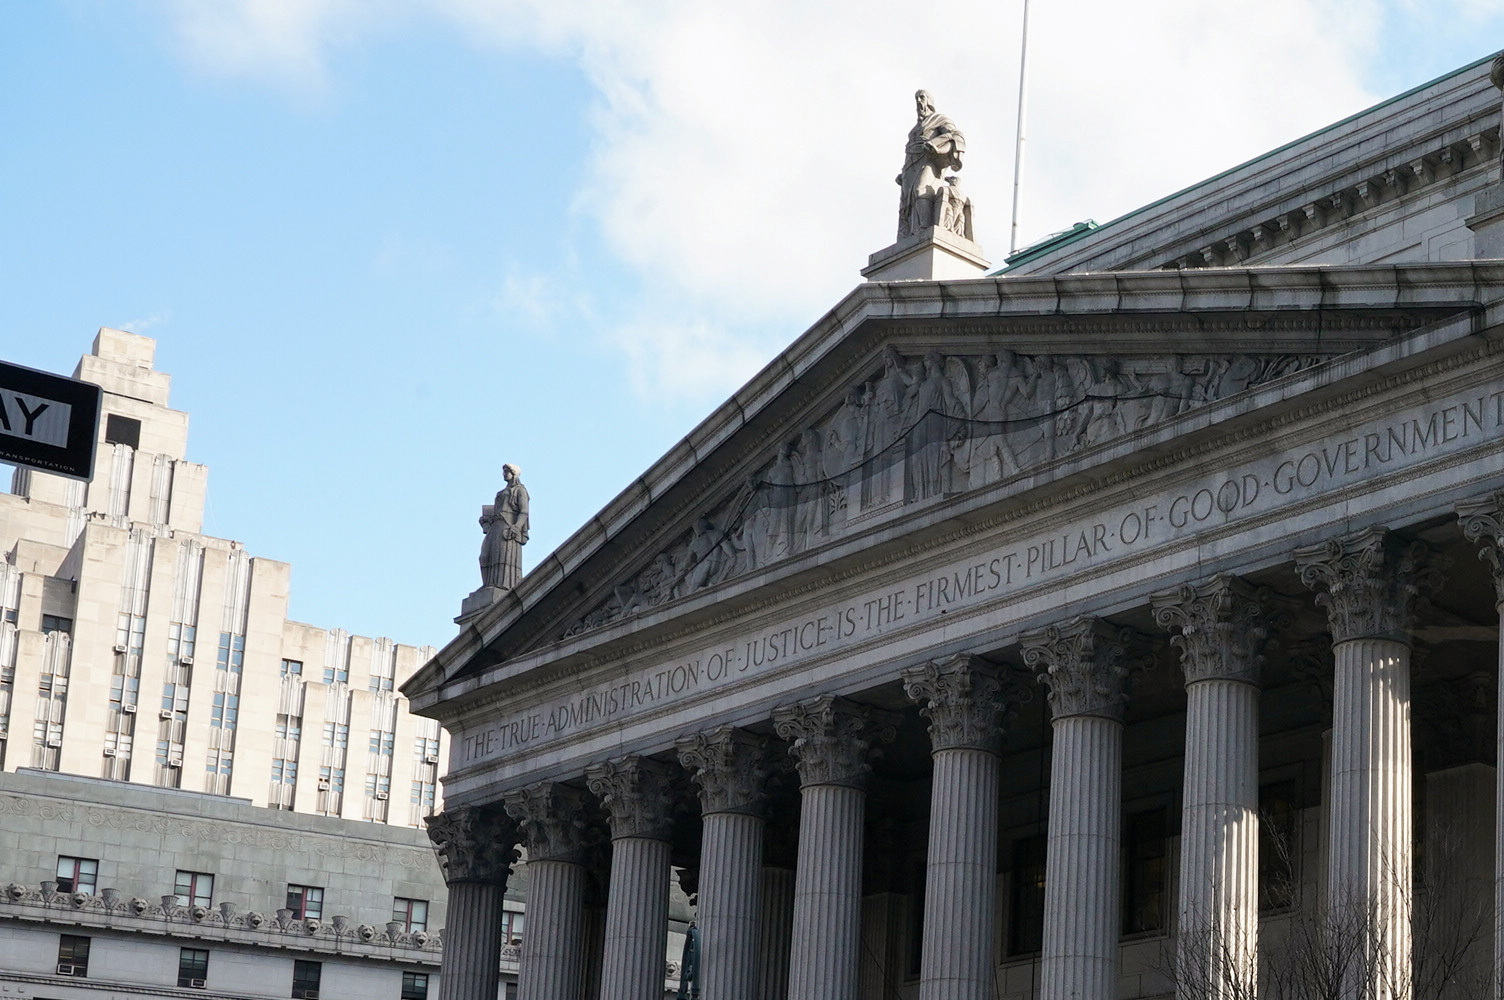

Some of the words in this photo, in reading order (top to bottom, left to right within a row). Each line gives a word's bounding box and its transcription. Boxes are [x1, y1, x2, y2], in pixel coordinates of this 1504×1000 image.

[465, 729, 495, 761] THE
[500, 714, 540, 750] TRUE
[546, 660, 699, 735] ADMINISTRATION
[707, 648, 734, 681] OF
[738, 616, 828, 672] JUSTICE
[836, 607, 856, 640] IS
[864, 590, 906, 631] THE
[914, 553, 1019, 615] FIRMEST
[1026, 524, 1112, 578] PILLAR
[1119, 505, 1159, 546] OF
[1169, 475, 1259, 528] GOOD
